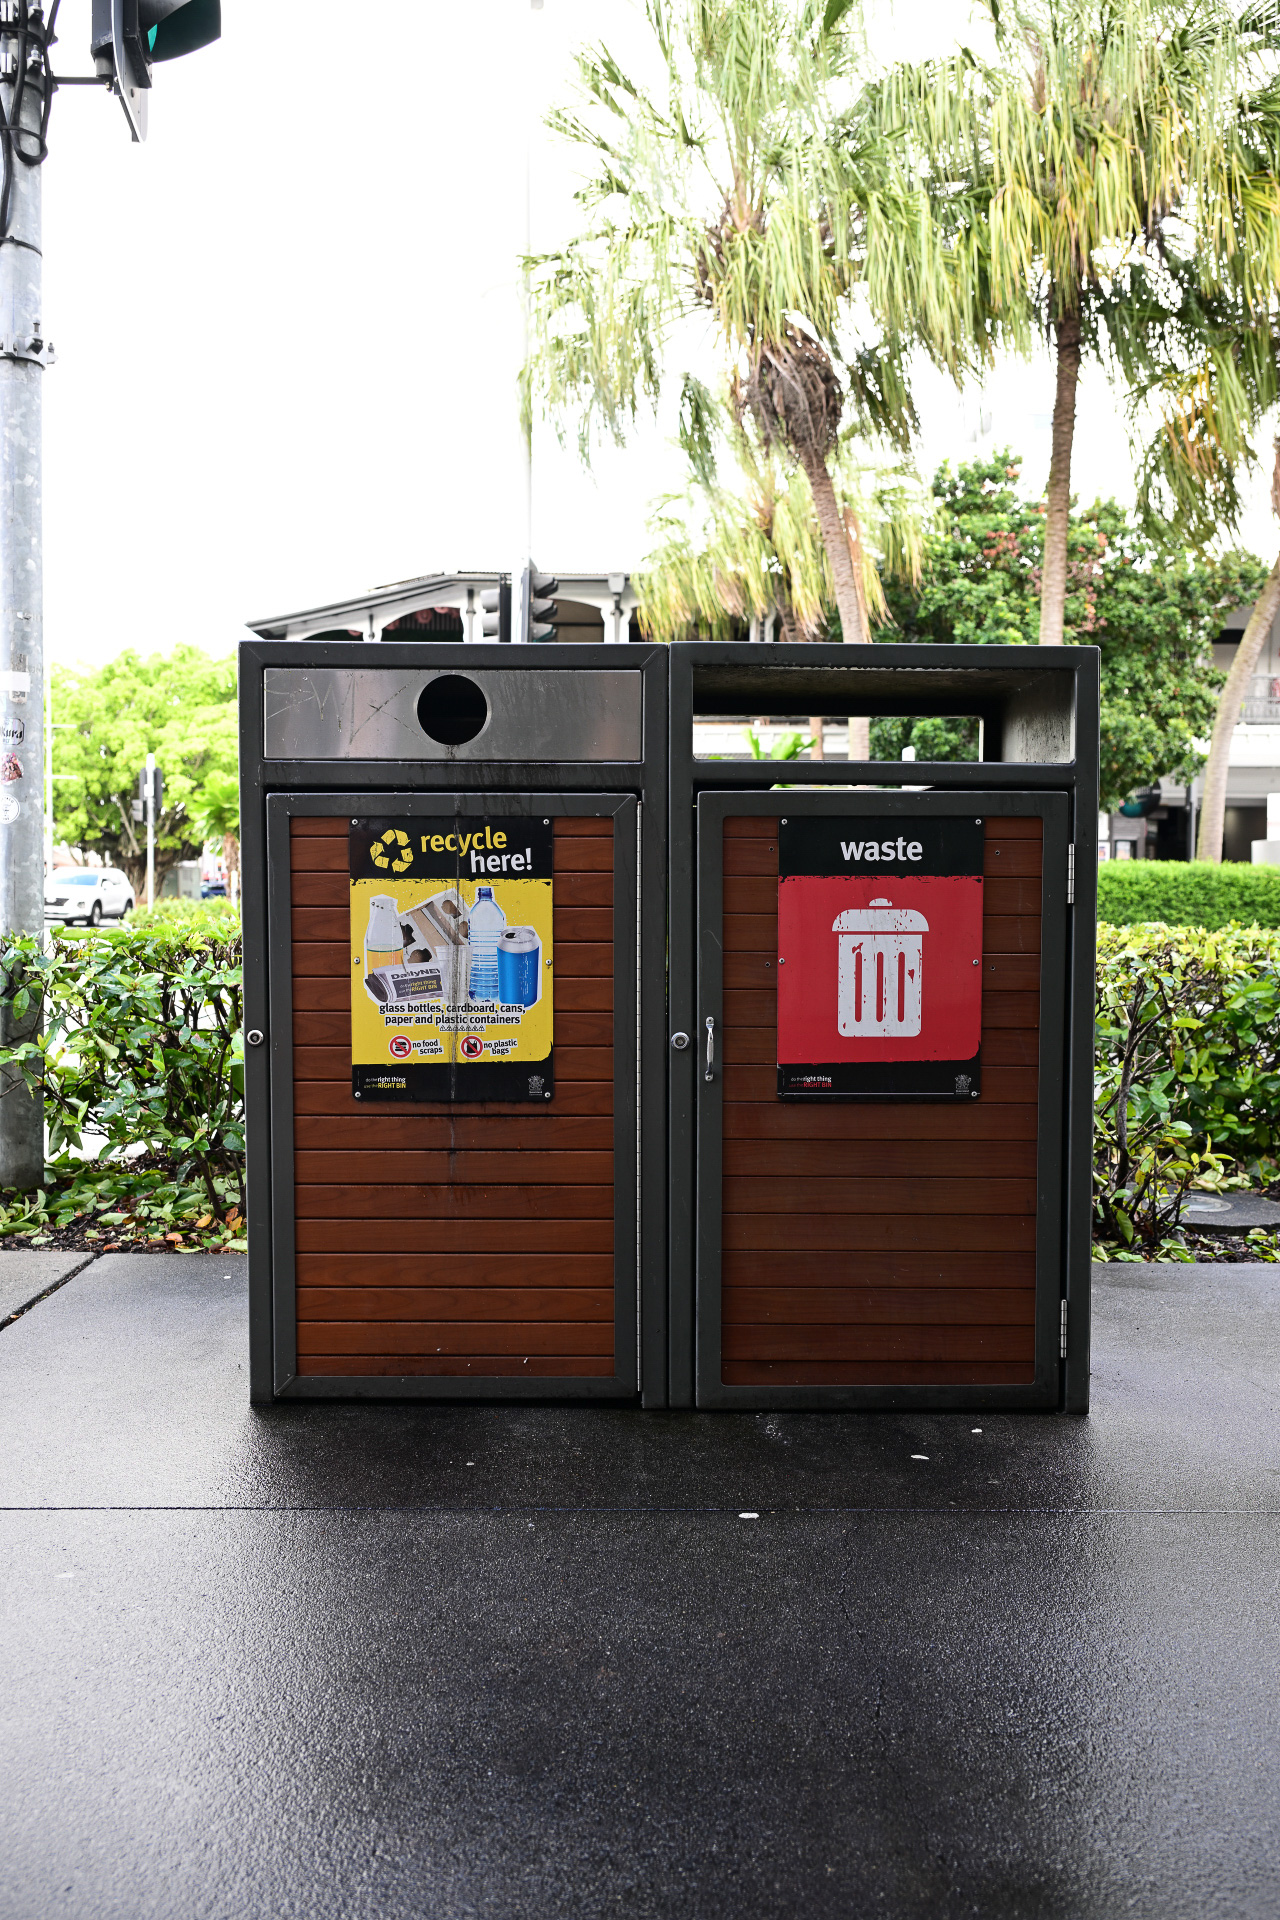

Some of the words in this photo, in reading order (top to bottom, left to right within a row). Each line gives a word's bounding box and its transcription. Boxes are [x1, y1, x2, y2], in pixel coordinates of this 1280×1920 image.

[420, 826, 507, 858] recycle
[840, 836, 923, 861] waste
[470, 848, 533, 873] here!
[379, 1004, 405, 1014] glass
[408, 1004, 444, 1014] bottles,
[446, 1003, 498, 1014] cardboard,
[500, 1004, 526, 1014] cans,
[385, 1015, 413, 1025] paper
[415, 1014, 433, 1023] and
[435, 1014, 467, 1025] plastic
[470, 1014, 520, 1024] containers
[422, 1039, 438, 1047] food
[494, 1039, 517, 1049] plastic
[419, 1047, 443, 1055] scraps
[492, 1047, 509, 1055] bags
